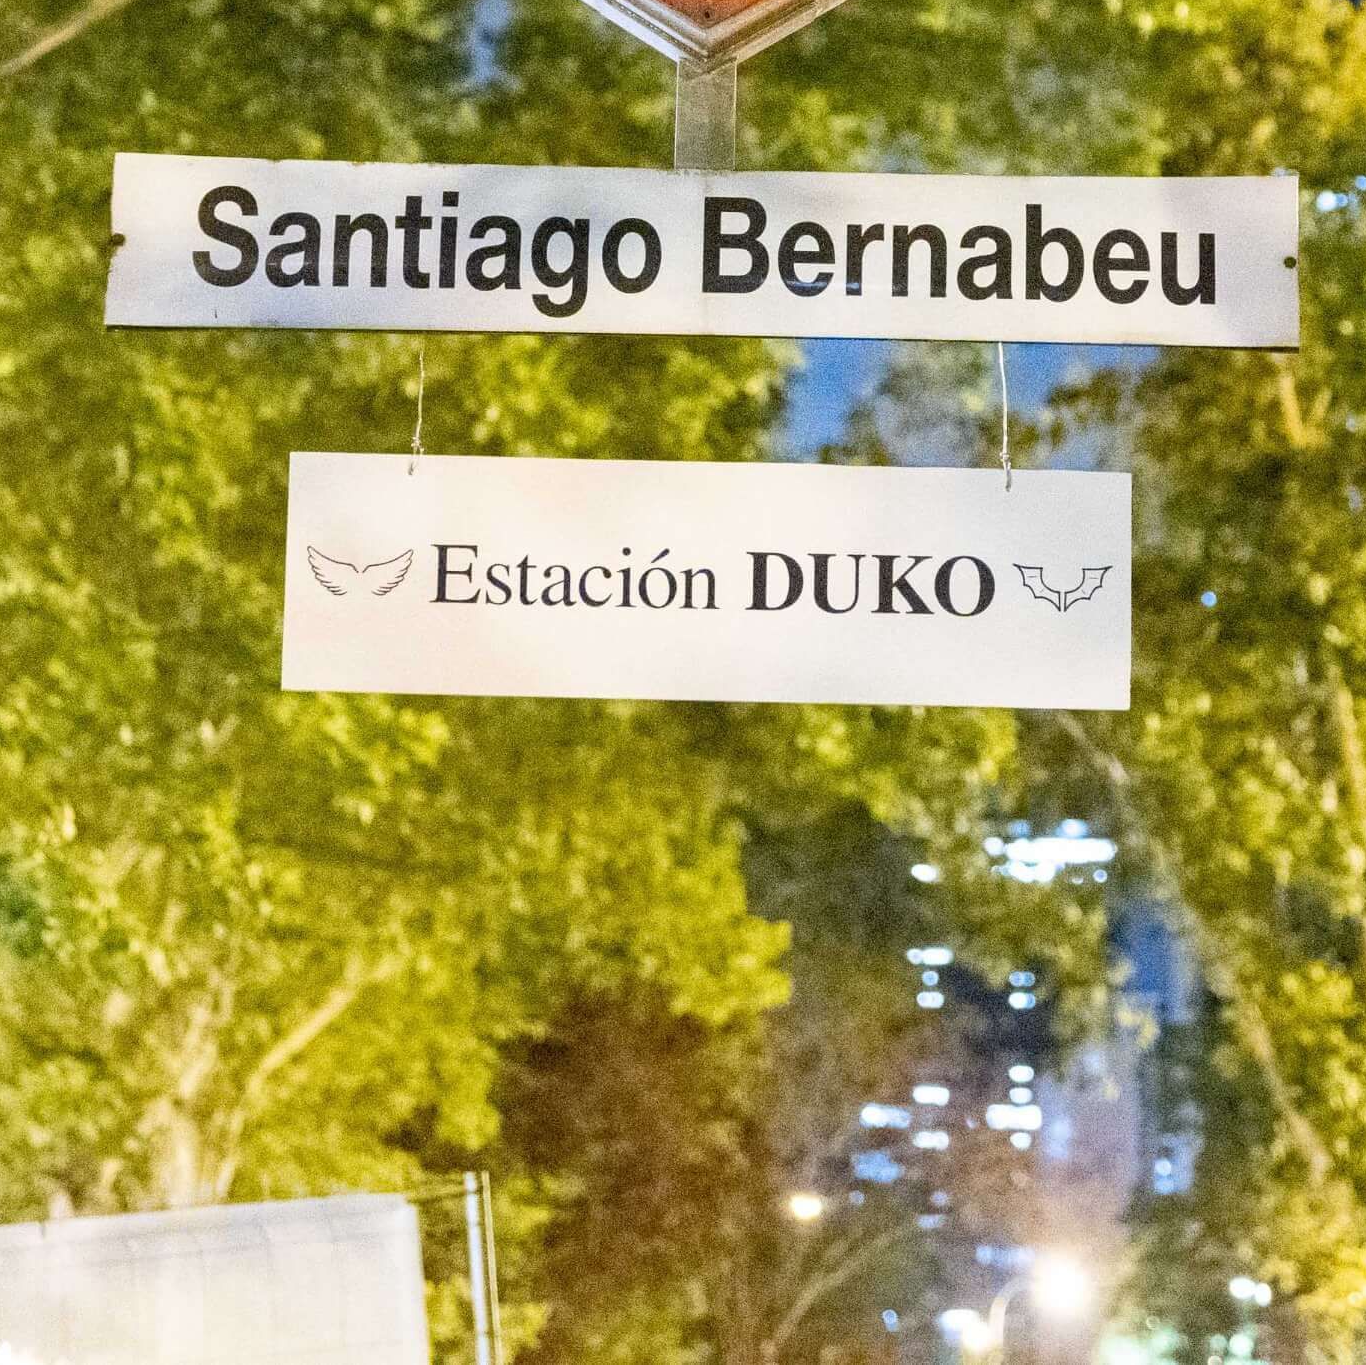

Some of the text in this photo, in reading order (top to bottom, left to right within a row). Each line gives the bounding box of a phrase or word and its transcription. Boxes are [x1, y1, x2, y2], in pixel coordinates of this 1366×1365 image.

[191, 184, 1218, 318] Santiago Bernabeu
[429, 542, 997, 618] Estación DUKO
